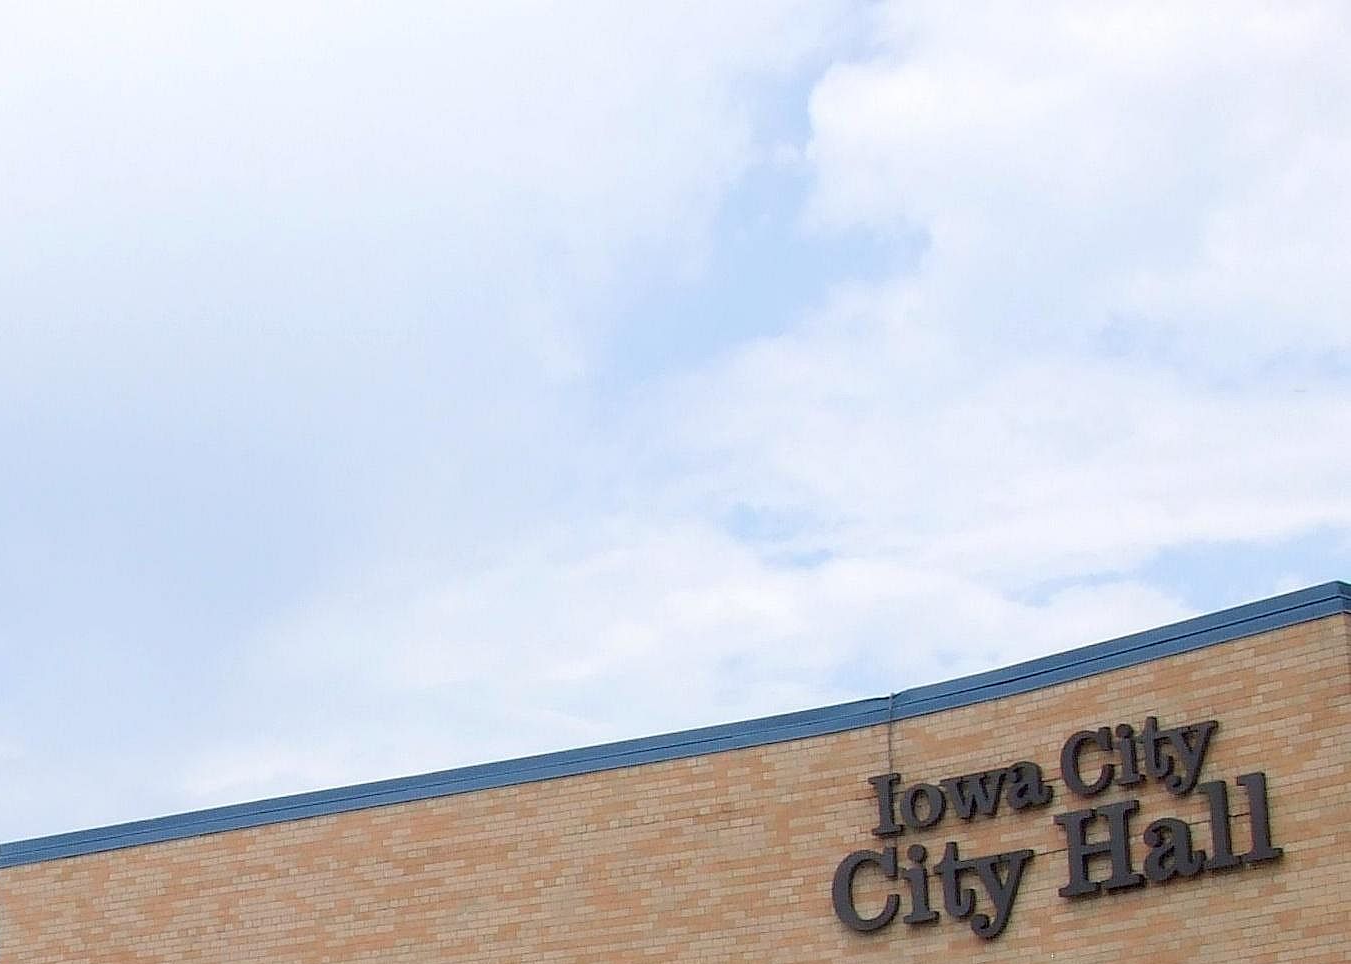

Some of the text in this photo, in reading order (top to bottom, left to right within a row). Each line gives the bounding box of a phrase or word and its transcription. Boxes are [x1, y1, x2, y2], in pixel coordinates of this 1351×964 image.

[868, 716, 1219, 838] Iowa City
[832, 772, 1285, 939] City Hall
